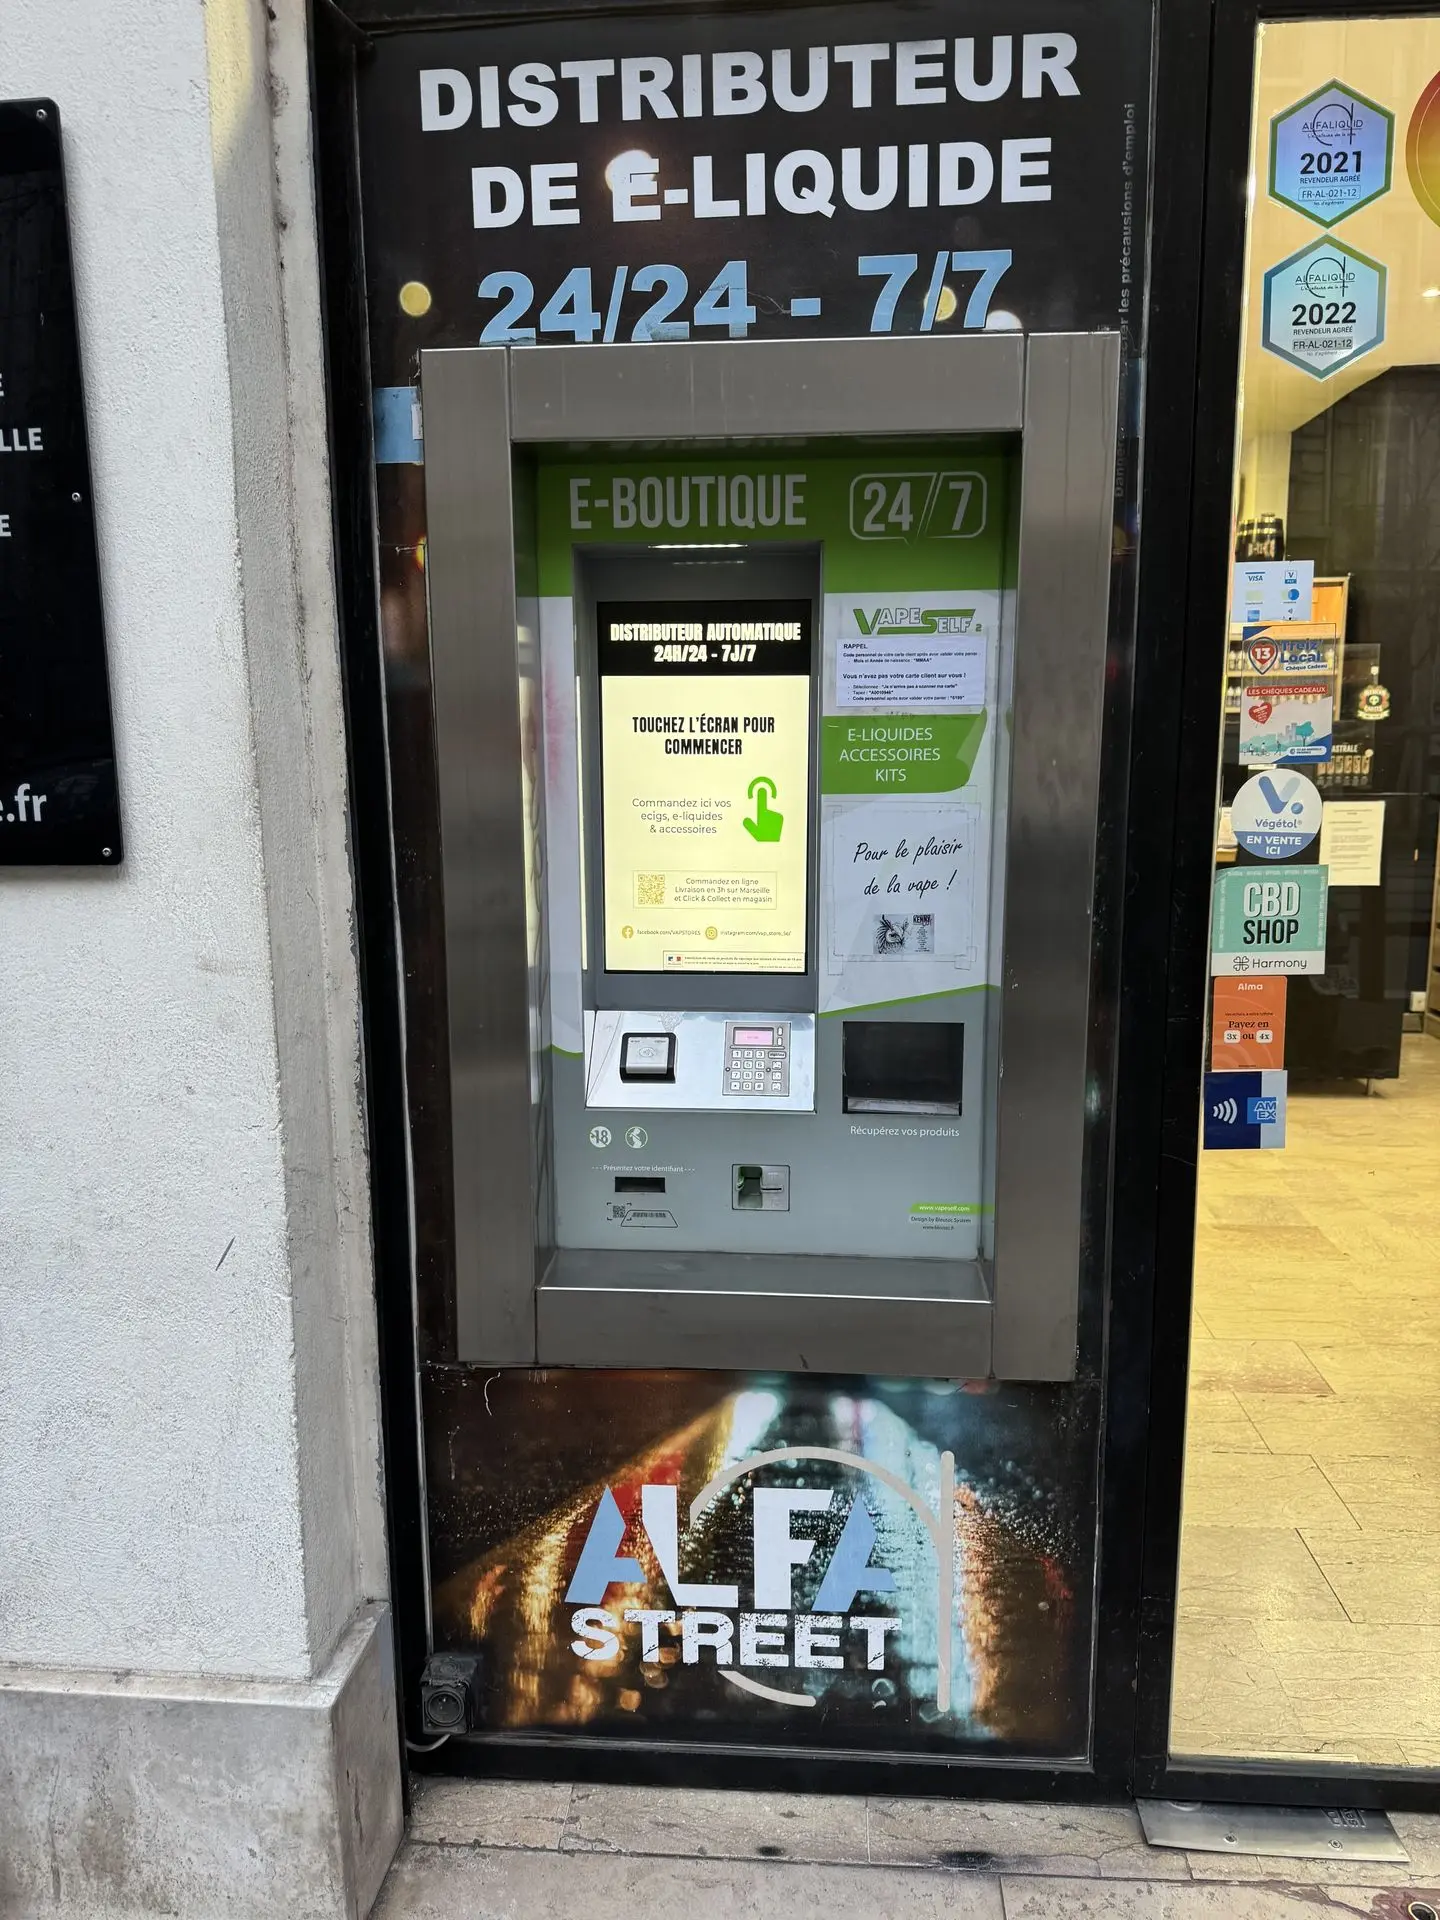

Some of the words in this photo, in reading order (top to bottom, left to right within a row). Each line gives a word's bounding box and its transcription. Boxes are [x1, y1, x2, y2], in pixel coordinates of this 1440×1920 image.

[419, 32, 1081, 132] DISTRIBUTEUR
[1302, 119, 1363, 130] ALFALIQUID
[1122, 102, 1137, 176] d'emploi
[1300, 150, 1362, 175] 2021
[470, 163, 580, 230] DE
[611, 137, 1053, 223] E-LIQUIDE
[1300, 176, 1339, 184] REVENDEUR
[1339, 174, 1361, 182] AGRÉÉ
[1302, 188, 1357, 198] FR-AL-021-12
[1120, 179, 1133, 284] précausions
[1295, 273, 1355, 283] ALFALIQUID
[477, 260, 757, 346] 24/24
[790, 297, 821, 316] -
[857, 249, 1013, 332] 7/7
[1118, 289, 1130, 313] les
[1292, 302, 1357, 326] 2022
[1293, 327, 1331, 335] REVENDEUR
[1293, 339, 1352, 350] FR-AL-021-12
[569, 474, 808, 530] E-BOUTIQUE
[610, 623, 703, 642] DISTRIBUTEUR
[706, 622, 801, 642] AUTOMATIQUE
[975, 623, 983, 632] 2
[1280, 639, 1324, 651] Treiz'
[653, 644, 708, 662] 24H/24
[721, 644, 757, 662] 7J/7
[1254, 647, 1271, 660] 13
[1280, 652, 1322, 664] Local
[1248, 688, 1261, 696] LES
[1294, 686, 1326, 694] CADEAUX
[632, 716, 685, 733] TOUCHEZ
[689, 713, 739, 733] L'ÉCRAN
[743, 716, 775, 733] POUR
[847, 727, 933, 743] E-LIQUIDES
[664, 738, 743, 755] COMMENCER
[839, 748, 941, 762] ACCESSOIRES
[875, 768, 907, 782] KITS
[632, 798, 698, 808] Commandez
[700, 798, 712, 808] ici
[714, 800, 732, 808] vos
[640, 811, 670, 823] ecigs,
[672, 811, 723, 823] e-liquides
[650, 824, 657, 834] &
[659, 824, 717, 834] accessoires
[1246, 835, 1262, 844] EN
[1266, 836, 1302, 845] VENTE
[853, 841, 888, 864] Pour
[894, 838, 910, 859] le
[912, 835, 964, 865] plaisir
[1265, 846, 1281, 855] ICI
[685, 877, 730, 885] Commandez
[741, 877, 759, 886] ligne
[863, 876, 880, 896] de
[886, 873, 901, 894] la
[907, 877, 940, 899] vape
[945, 868, 958, 891] !
[742, 896, 773, 904] magasin
[1243, 881, 1300, 918] CBD
[1242, 919, 1299, 945] SHOP
[1252, 958, 1308, 970] Harmony
[1237, 982, 1264, 991] Alma
[1228, 1020, 1257, 1030] Payez
[1257, 1021, 1269, 1029] en
[1242, 1033, 1255, 1041] ou
[1254, 1100, 1276, 1110] AM
[849, 1125, 899, 1137] Récupérez
[901, 1128, 918, 1136] vos
[919, 1127, 960, 1138] produits
[603, 1163, 633, 1172] Présentez
[651, 1165, 684, 1173] identifiant
[565, 1484, 898, 1613] ALFA
[570, 1608, 902, 1670] STREET
